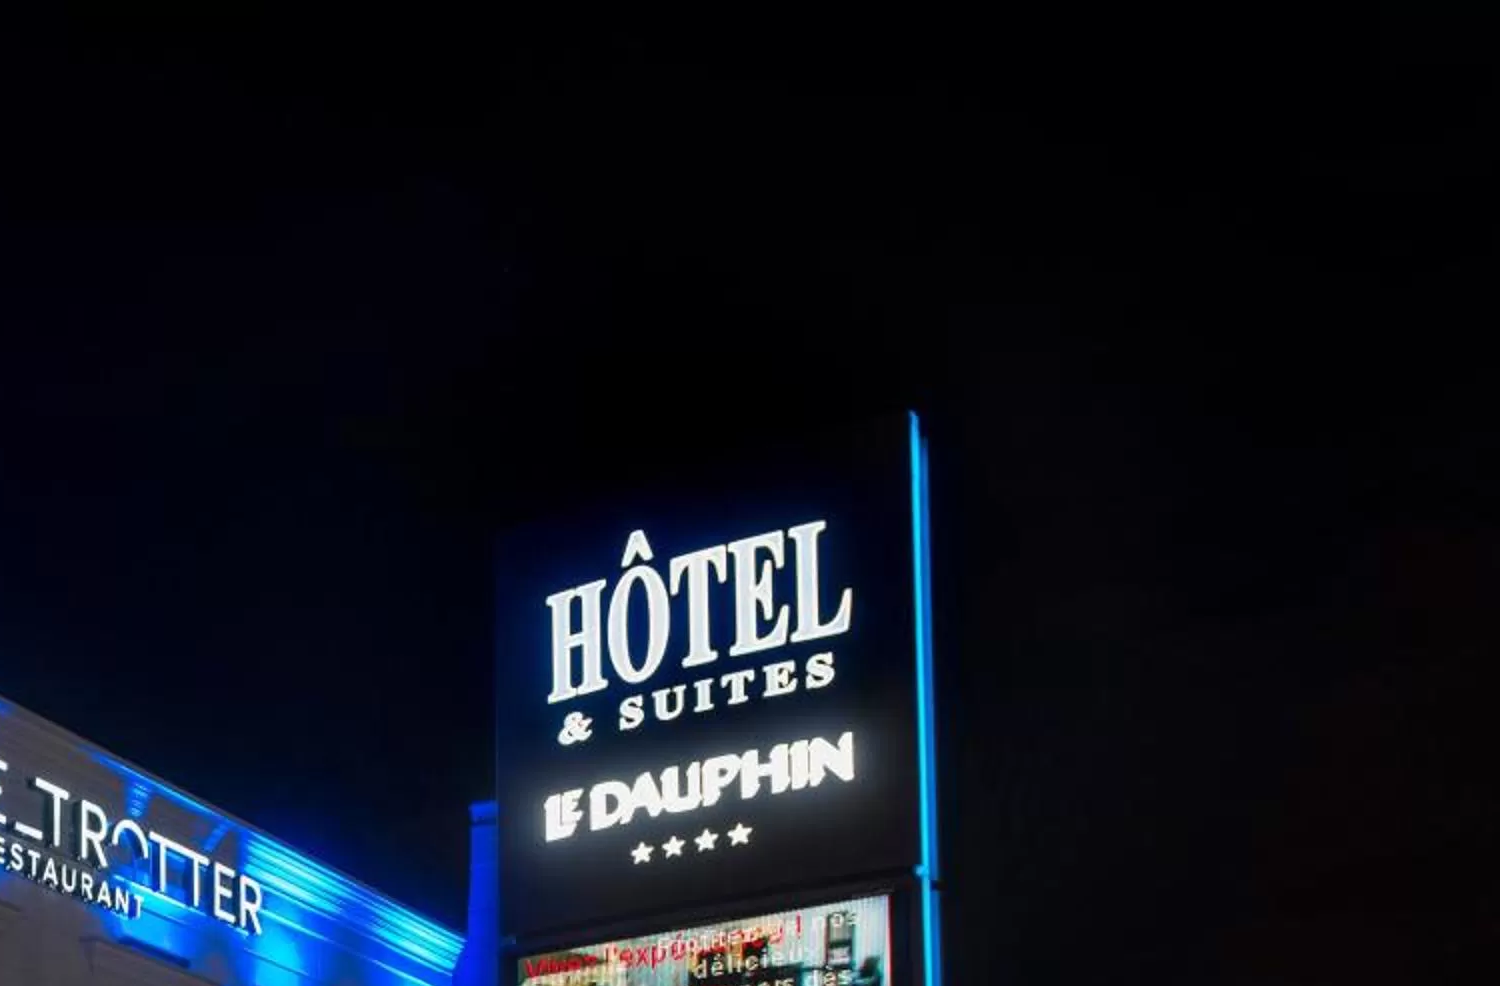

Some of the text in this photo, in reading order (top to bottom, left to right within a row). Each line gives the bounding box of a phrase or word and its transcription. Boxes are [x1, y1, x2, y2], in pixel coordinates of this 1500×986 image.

[546, 520, 853, 704] HÔTEL
[557, 651, 836, 745] & SUITES
[589, 731, 854, 831] DAUPHIN
